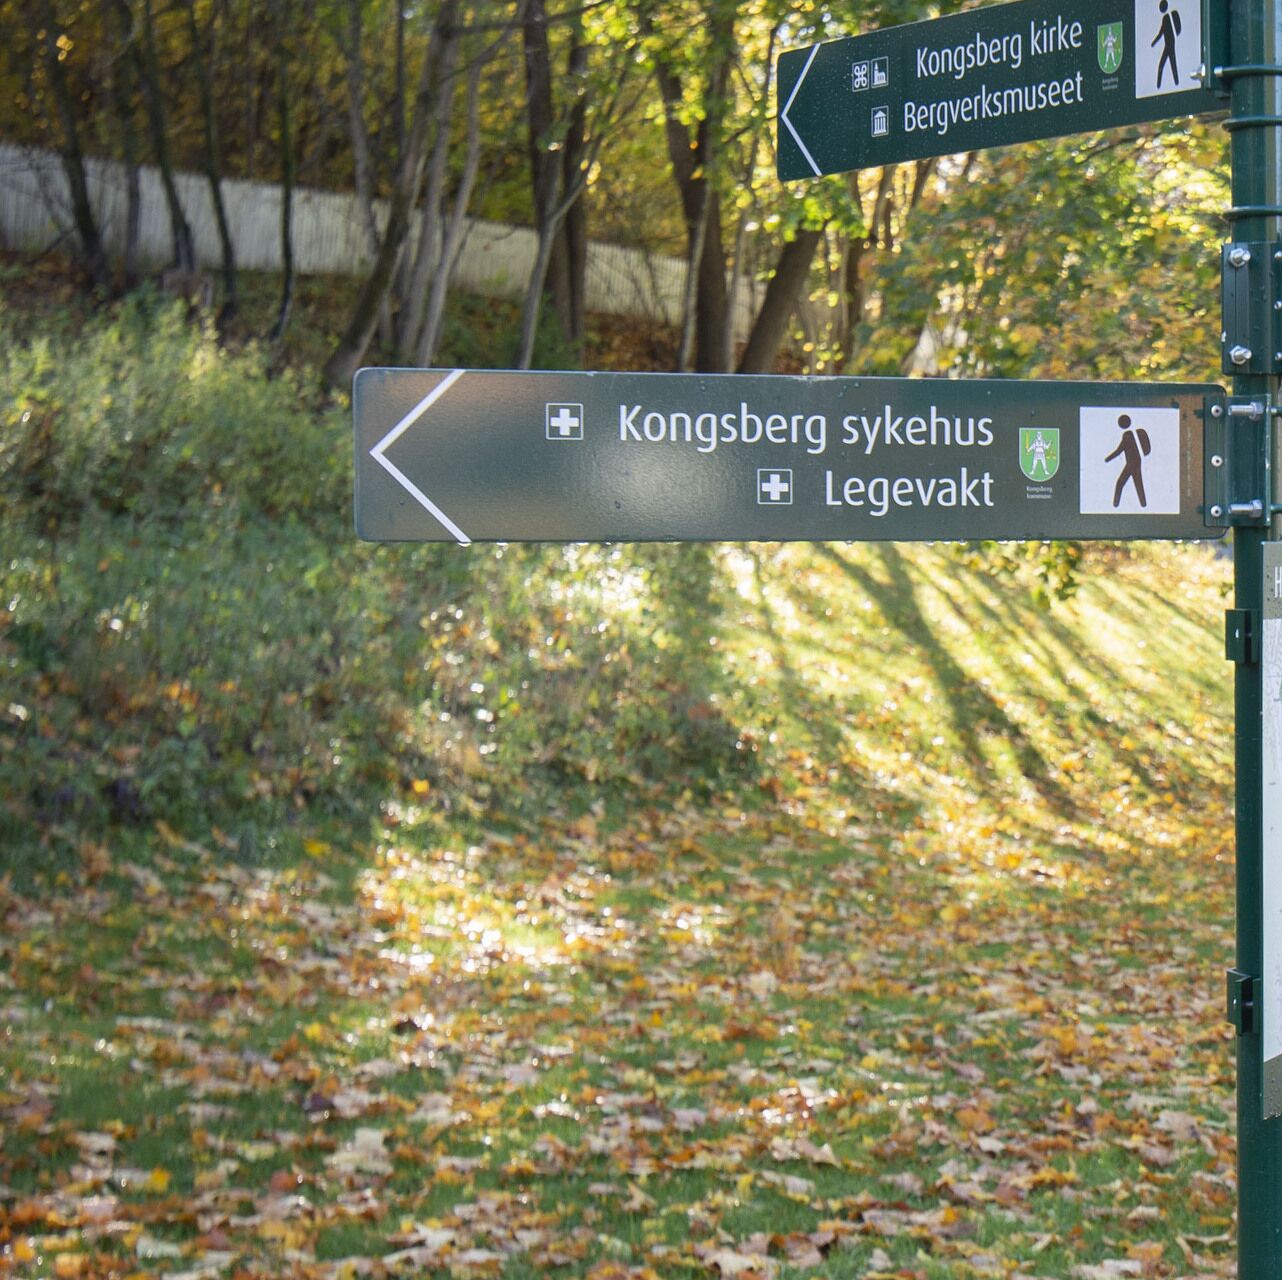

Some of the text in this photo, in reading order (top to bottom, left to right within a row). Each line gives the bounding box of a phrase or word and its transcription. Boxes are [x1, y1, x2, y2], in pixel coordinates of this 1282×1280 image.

[916, 15, 1083, 80] Kongsberg kirke
[904, 70, 1084, 136] Bergverksmuseet
[620, 403, 994, 455] Kongsberg sykehus
[825, 467, 995, 517] Legevakt
